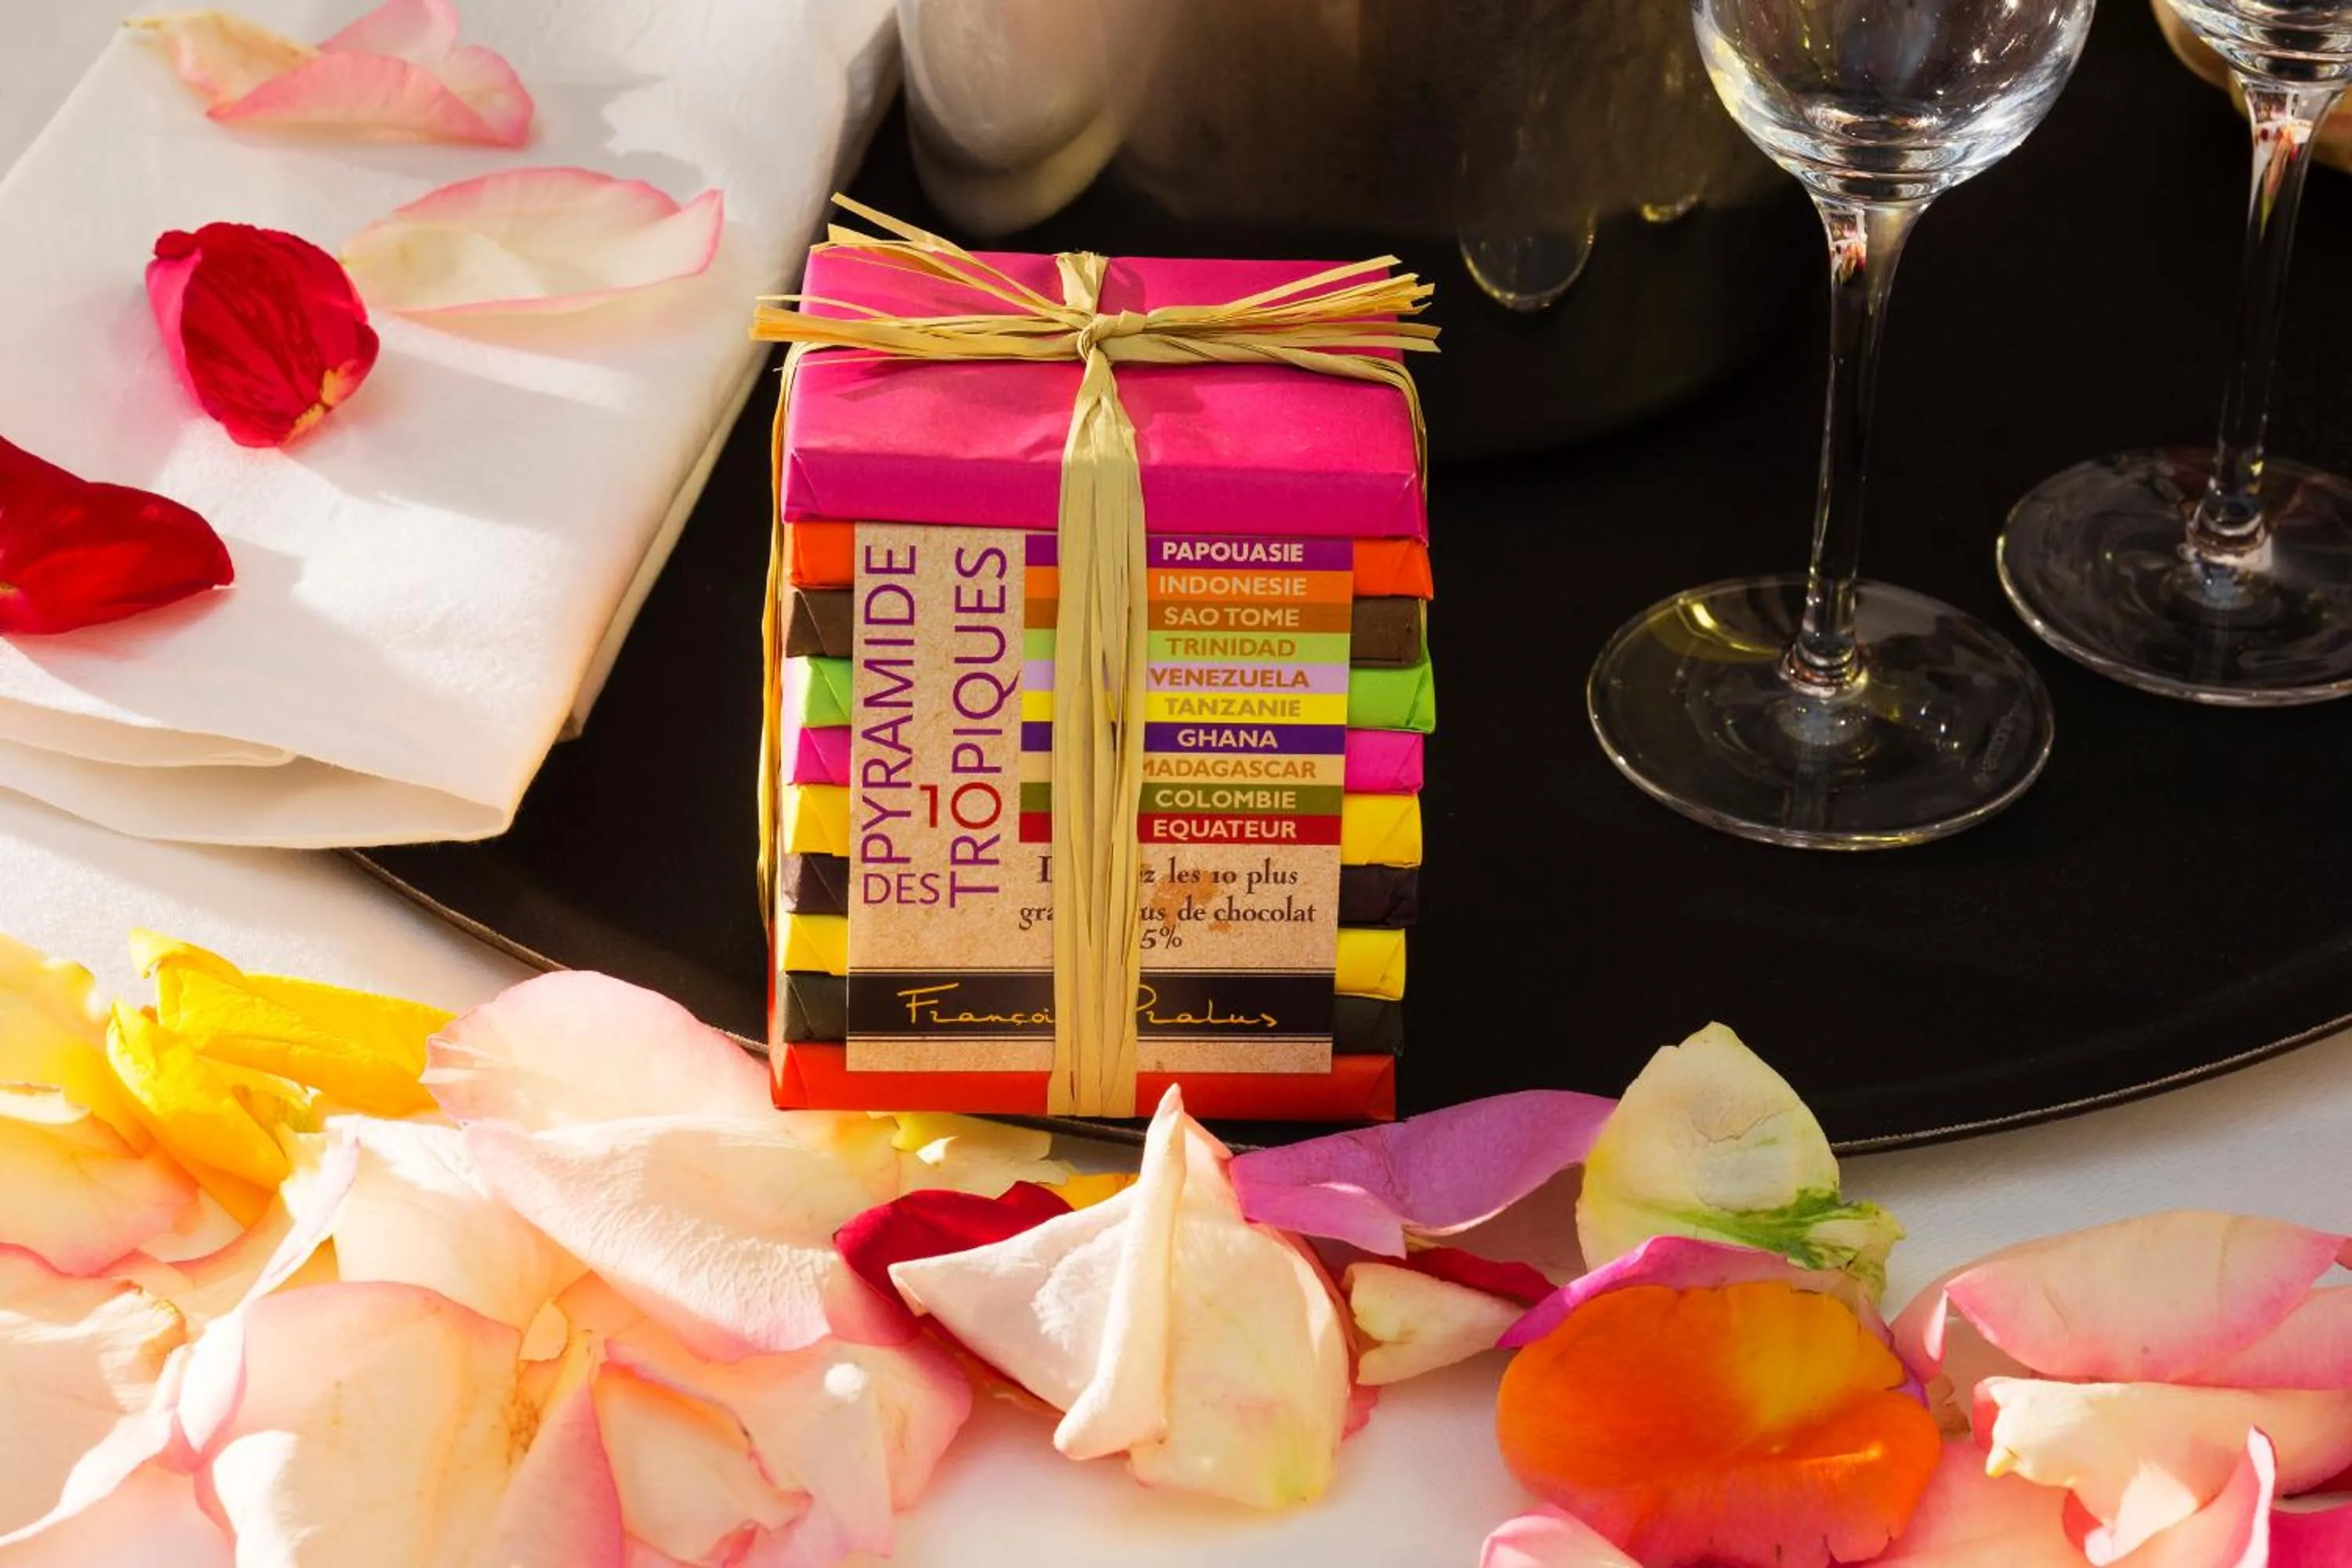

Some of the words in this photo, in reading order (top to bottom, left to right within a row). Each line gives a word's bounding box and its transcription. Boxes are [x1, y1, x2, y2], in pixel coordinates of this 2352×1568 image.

[1162, 542, 1304, 562] PAPOUASIE
[1159, 575, 1307, 596] INDONESIE
[1164, 607, 1219, 626] SAO
[1224, 608, 1300, 626] TOME
[1164, 637, 1296, 658] TRINIDAD
[1149, 668, 1309, 688] VENEZUELA
[861, 545, 916, 864] PYRAMIDE
[1164, 698, 1301, 717] TANZANIE
[949, 546, 1020, 908] TROPIQUES
[1177, 729, 1278, 749] GHANA
[1155, 789, 1297, 809] COLOMBIE
[1153, 819, 1298, 840] EQUATEUR
[1168, 856, 1200, 884] les
[1212, 870, 1237, 884] 10
[1247, 858, 1298, 895] plus
[863, 873, 940, 904] DES
[1177, 894, 1206, 921] de
[1214, 895, 1316, 923] chocolat
[1140, 924, 1182, 949] 5%
[897, 982, 1054, 1026] Françoi
